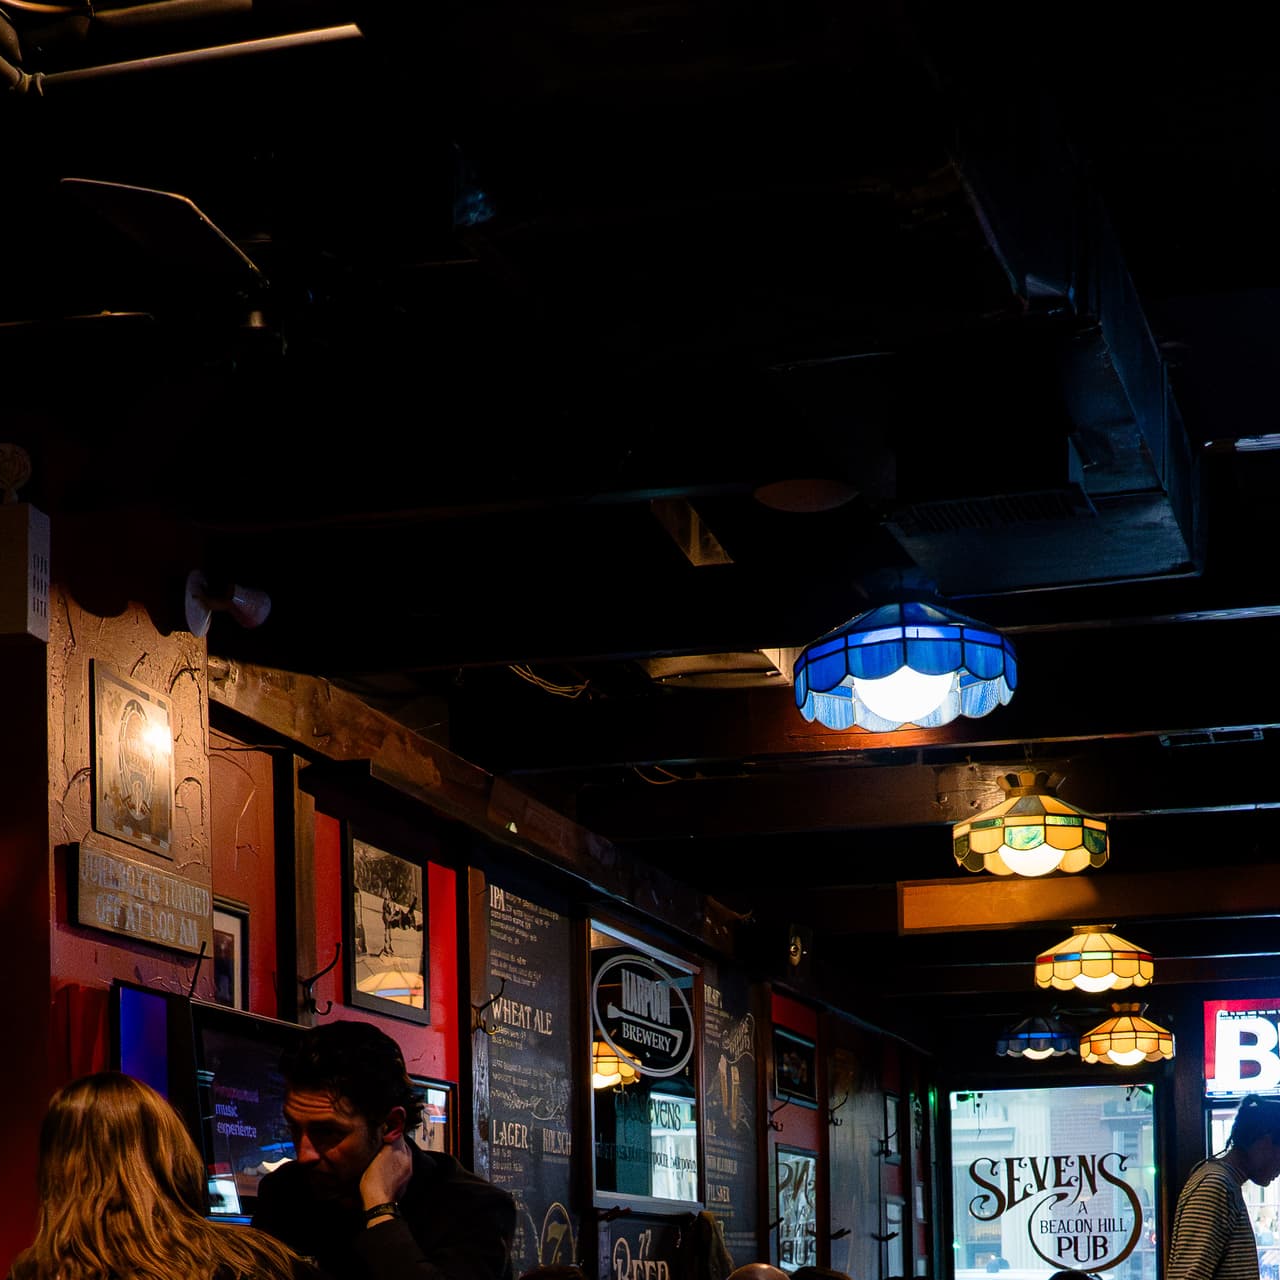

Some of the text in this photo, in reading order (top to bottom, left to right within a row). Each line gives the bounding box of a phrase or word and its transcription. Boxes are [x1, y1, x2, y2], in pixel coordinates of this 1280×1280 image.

[489, 883, 506, 912] IPA
[490, 993, 532, 1030] WHEAT
[534, 1009, 553, 1036] ALE
[621, 1021, 672, 1053] BREWERY
[492, 1119, 528, 1150] LAGER
[969, 1153, 1142, 1222] SEVENS
[1077, 1200, 1089, 1215] A
[1040, 1217, 1128, 1234] BEACON HILL
[1056, 1235, 1109, 1263] PUB
